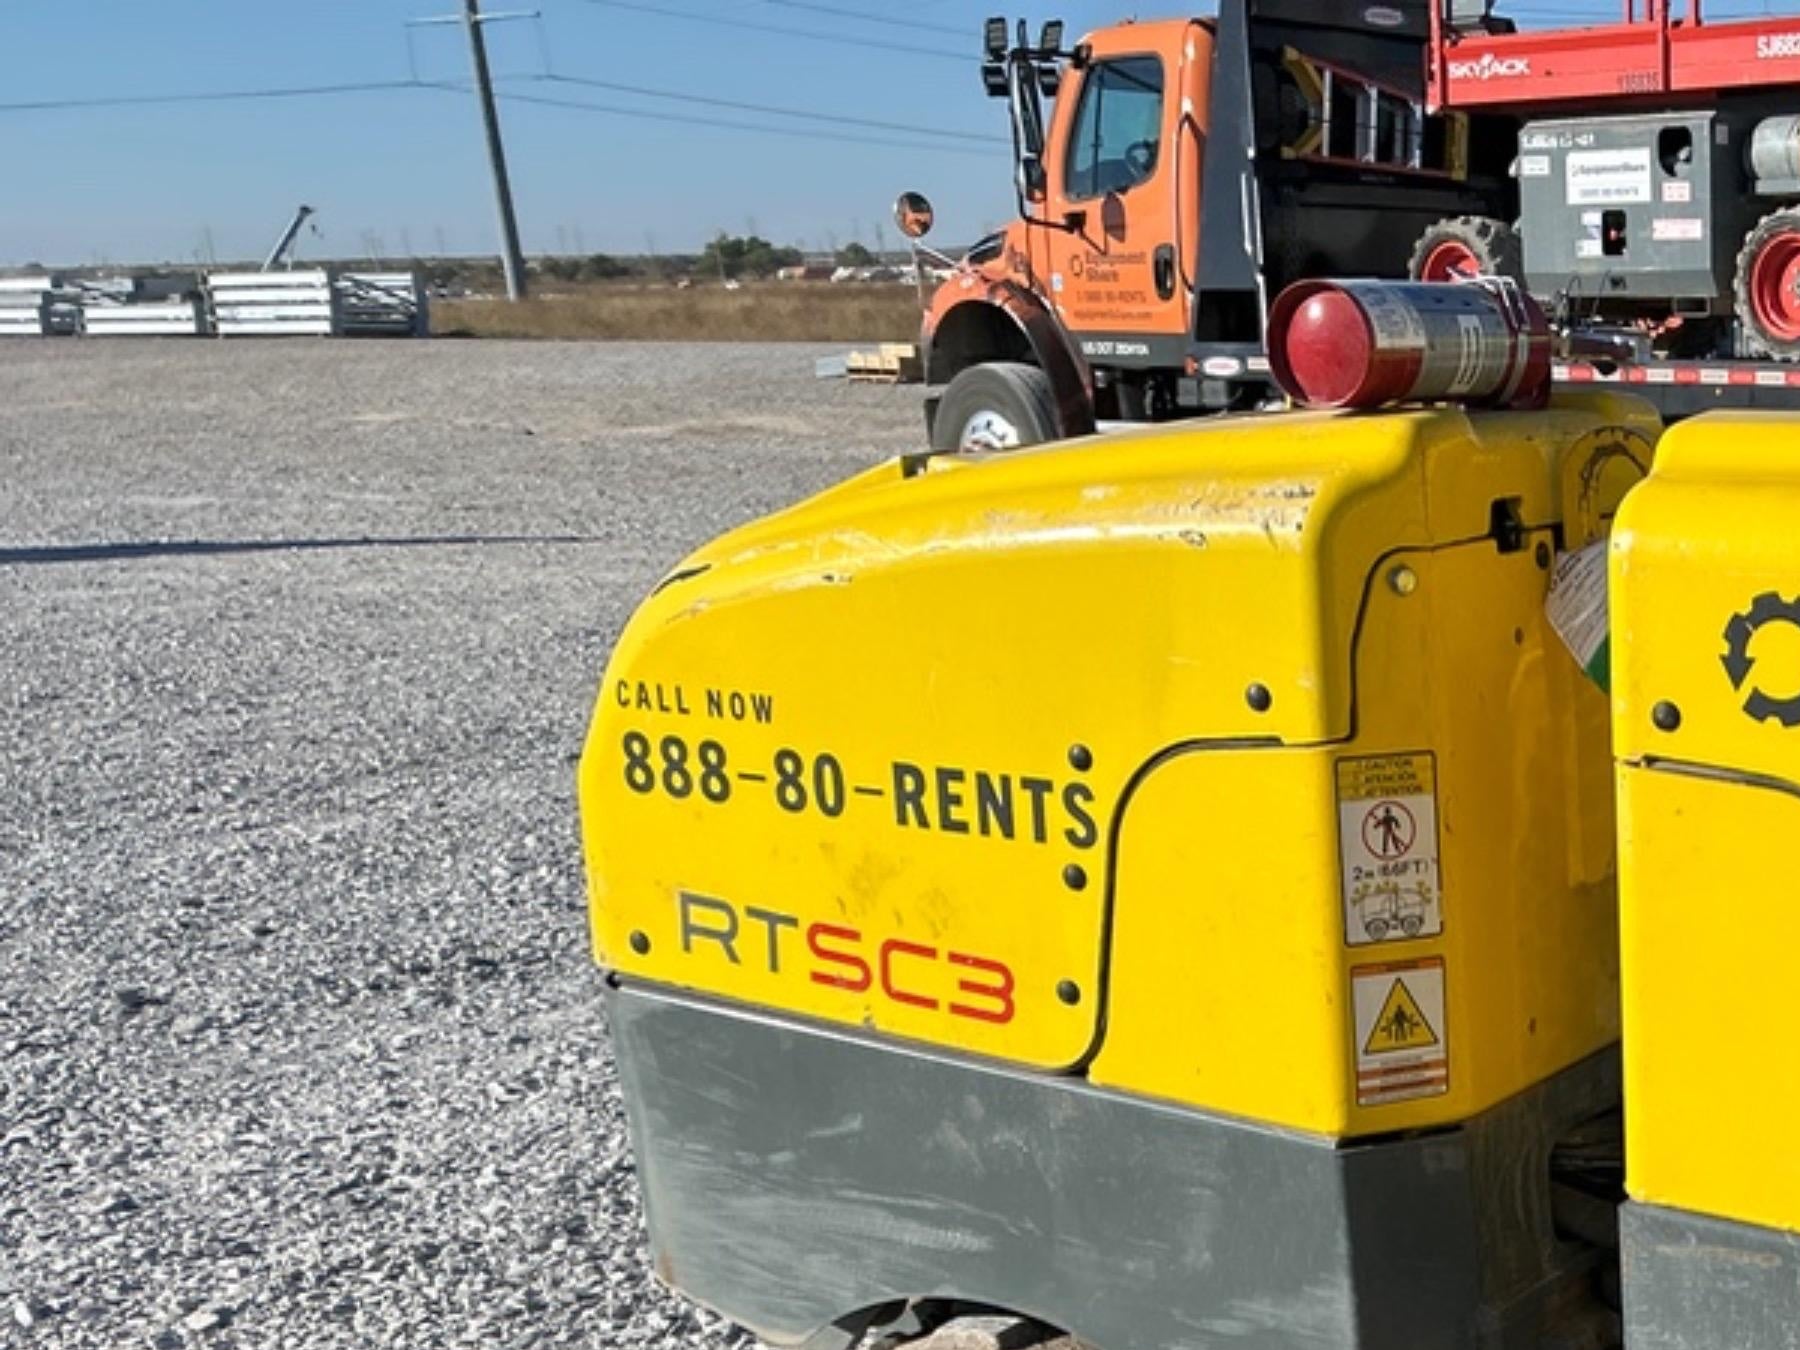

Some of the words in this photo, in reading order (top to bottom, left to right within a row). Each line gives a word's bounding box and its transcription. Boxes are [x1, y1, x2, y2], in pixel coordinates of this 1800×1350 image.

[1447, 52, 1531, 80] SKYJACK
[617, 680, 690, 715] CALL
[706, 689, 773, 723] NOW
[622, 731, 1098, 850] 888-80-RENTS
[680, 892, 1016, 1024] RTSC3
